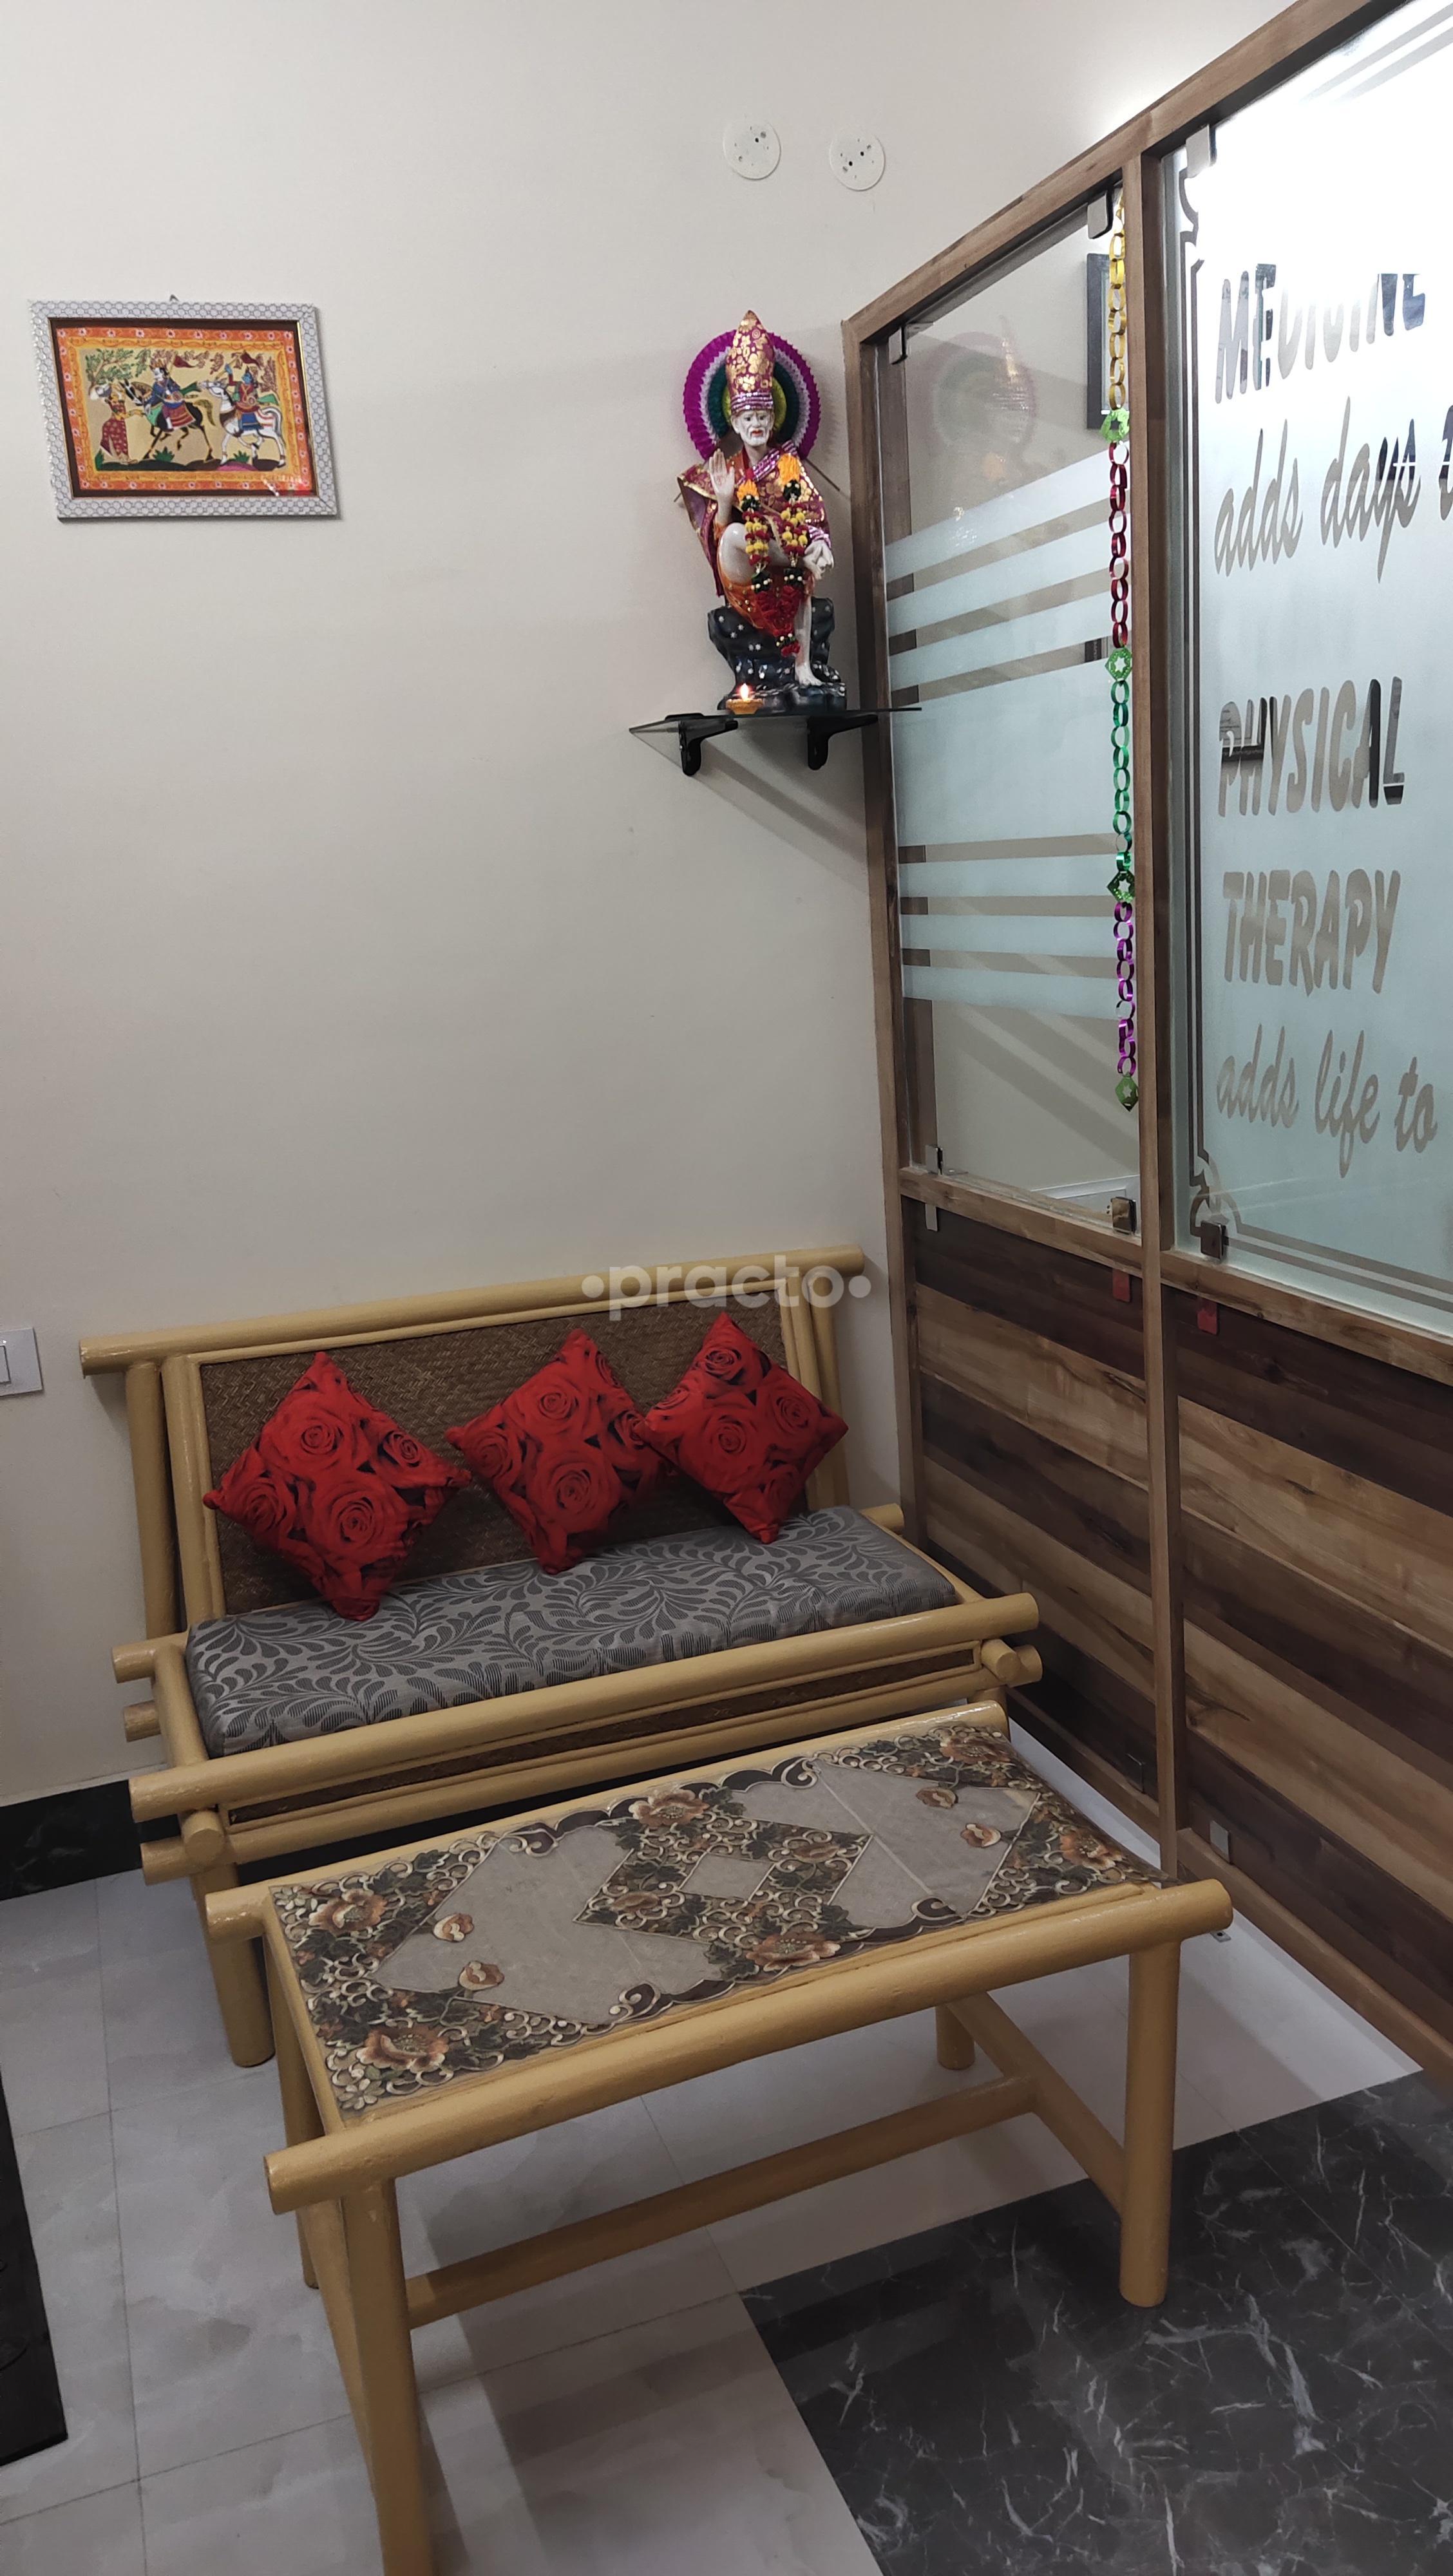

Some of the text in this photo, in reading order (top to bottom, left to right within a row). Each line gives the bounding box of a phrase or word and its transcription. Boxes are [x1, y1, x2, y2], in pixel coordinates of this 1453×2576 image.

[1215, 419, 1302, 576] adds
[1320, 395, 1421, 583] days
[1219, 676, 1404, 817] PHYSICAL
[1223, 869, 1400, 996] THERAPY
[1217, 1025, 1438, 1179] adds life to
